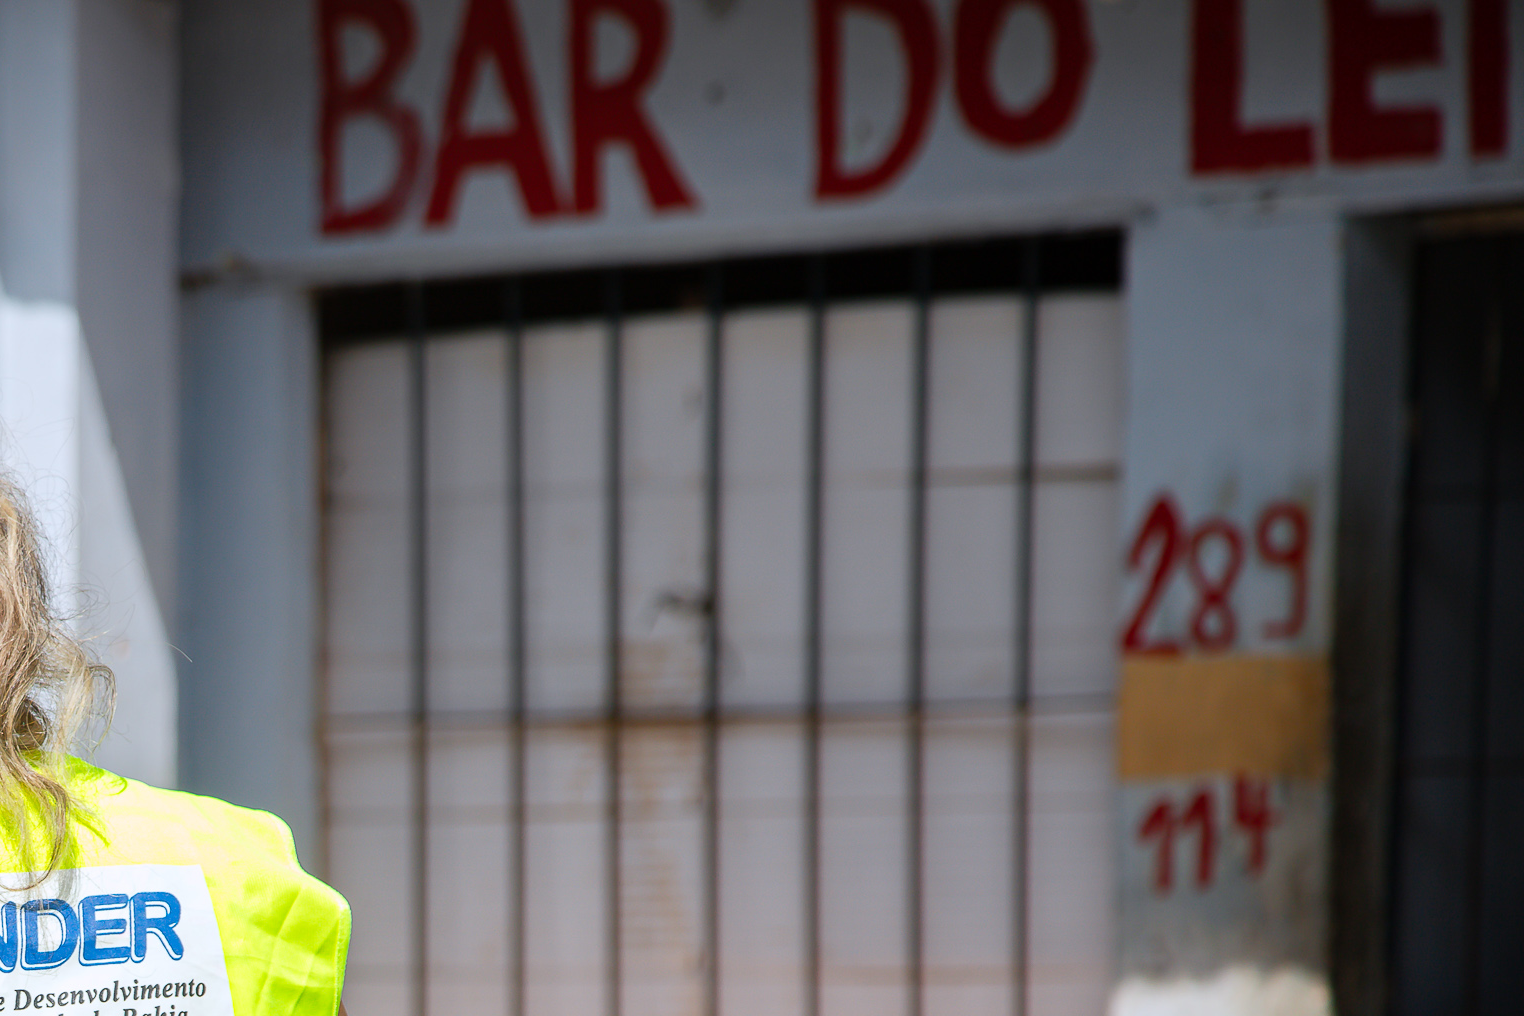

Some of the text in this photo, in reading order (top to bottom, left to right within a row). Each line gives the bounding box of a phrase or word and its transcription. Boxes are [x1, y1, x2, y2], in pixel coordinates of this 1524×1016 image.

[318, 0, 698, 236] BAR
[813, 0, 1095, 202] DO
[1119, 490, 1312, 655] 289
[1137, 773, 1279, 893] 114
[13, 979, 207, 1011] Desenvolvimento
